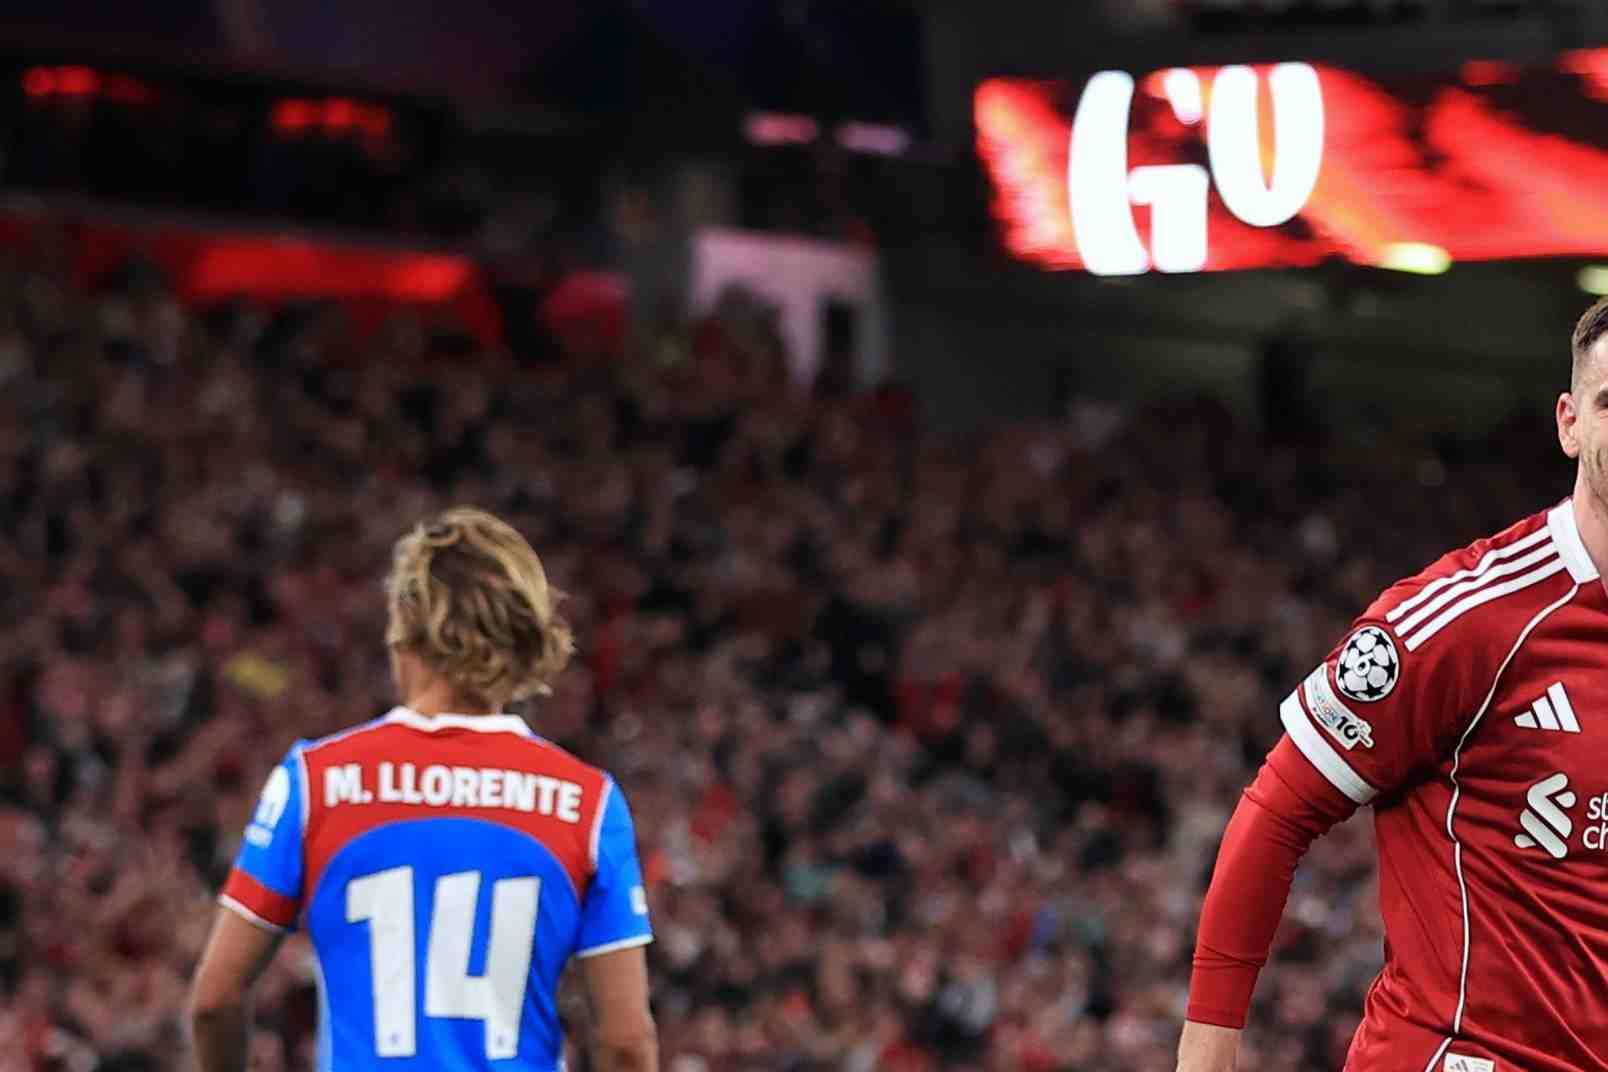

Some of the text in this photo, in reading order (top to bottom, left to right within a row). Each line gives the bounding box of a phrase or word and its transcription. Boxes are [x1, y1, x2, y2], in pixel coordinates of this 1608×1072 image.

[324, 761, 583, 823] M. LLORENTE
[345, 866, 541, 1060] 14
